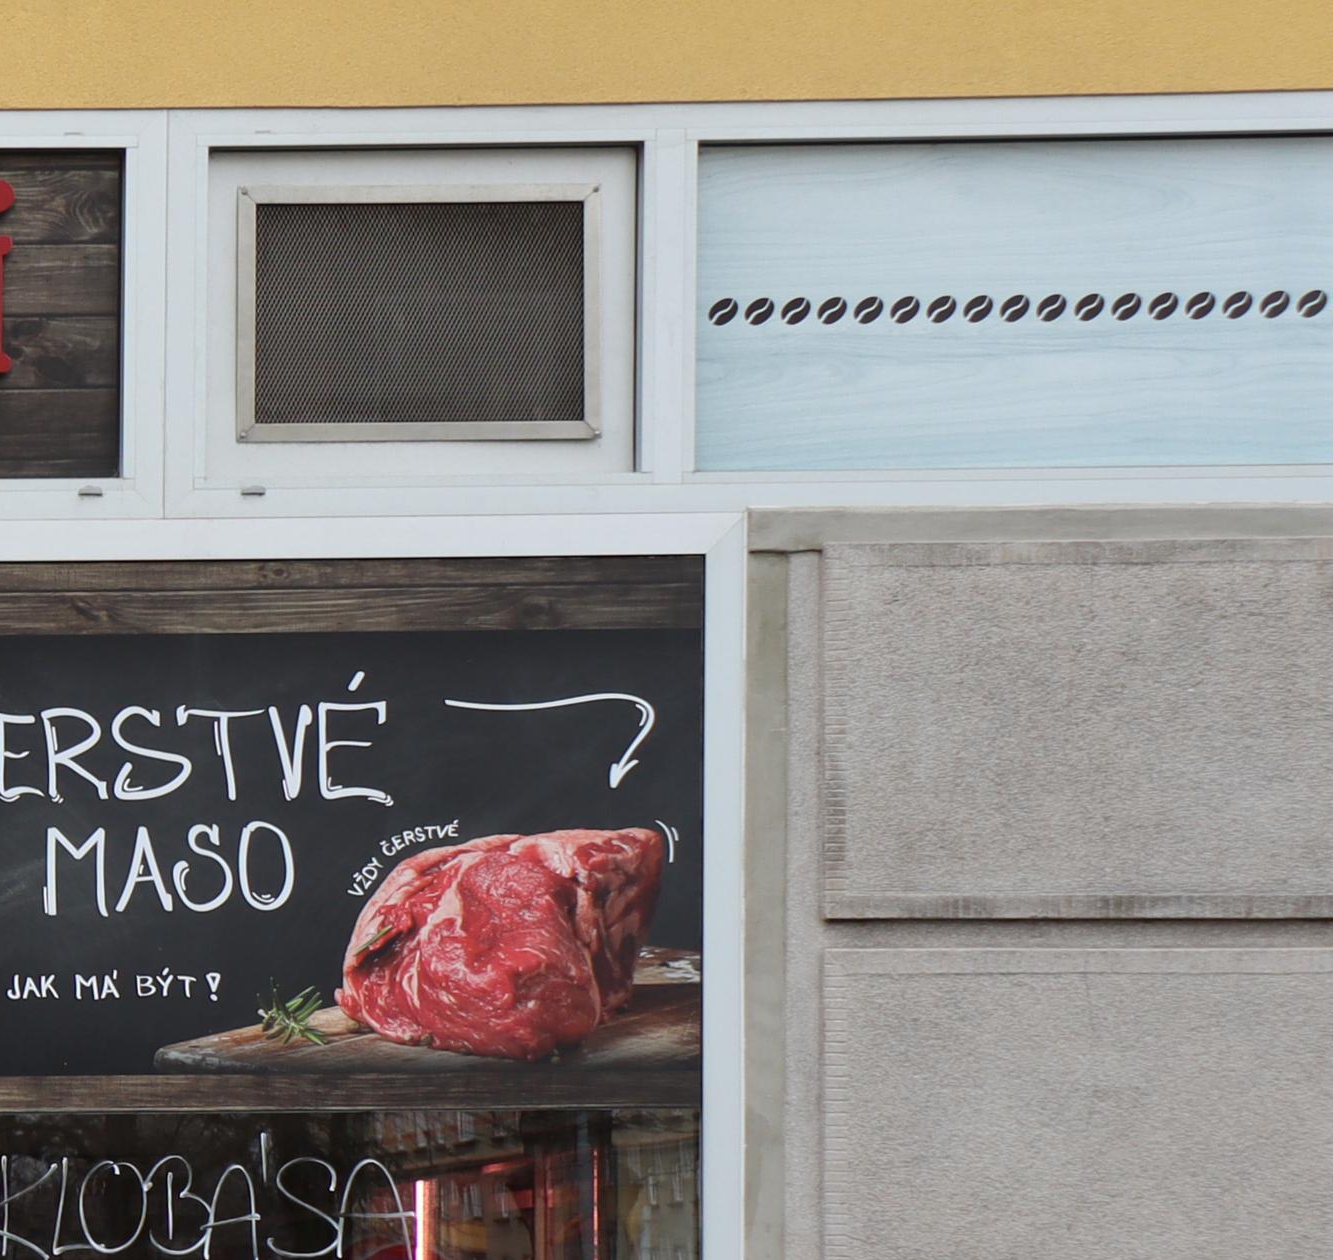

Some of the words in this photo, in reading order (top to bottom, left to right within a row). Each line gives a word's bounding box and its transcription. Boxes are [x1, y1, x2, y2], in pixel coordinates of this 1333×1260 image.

[42, 820, 296, 917] MASO
[347, 857, 384, 896] VŽDY
[379, 819, 459, 856] ČERSTVÉ
[6, 974, 60, 1000] JAK
[74, 970, 120, 1000] MÁ
